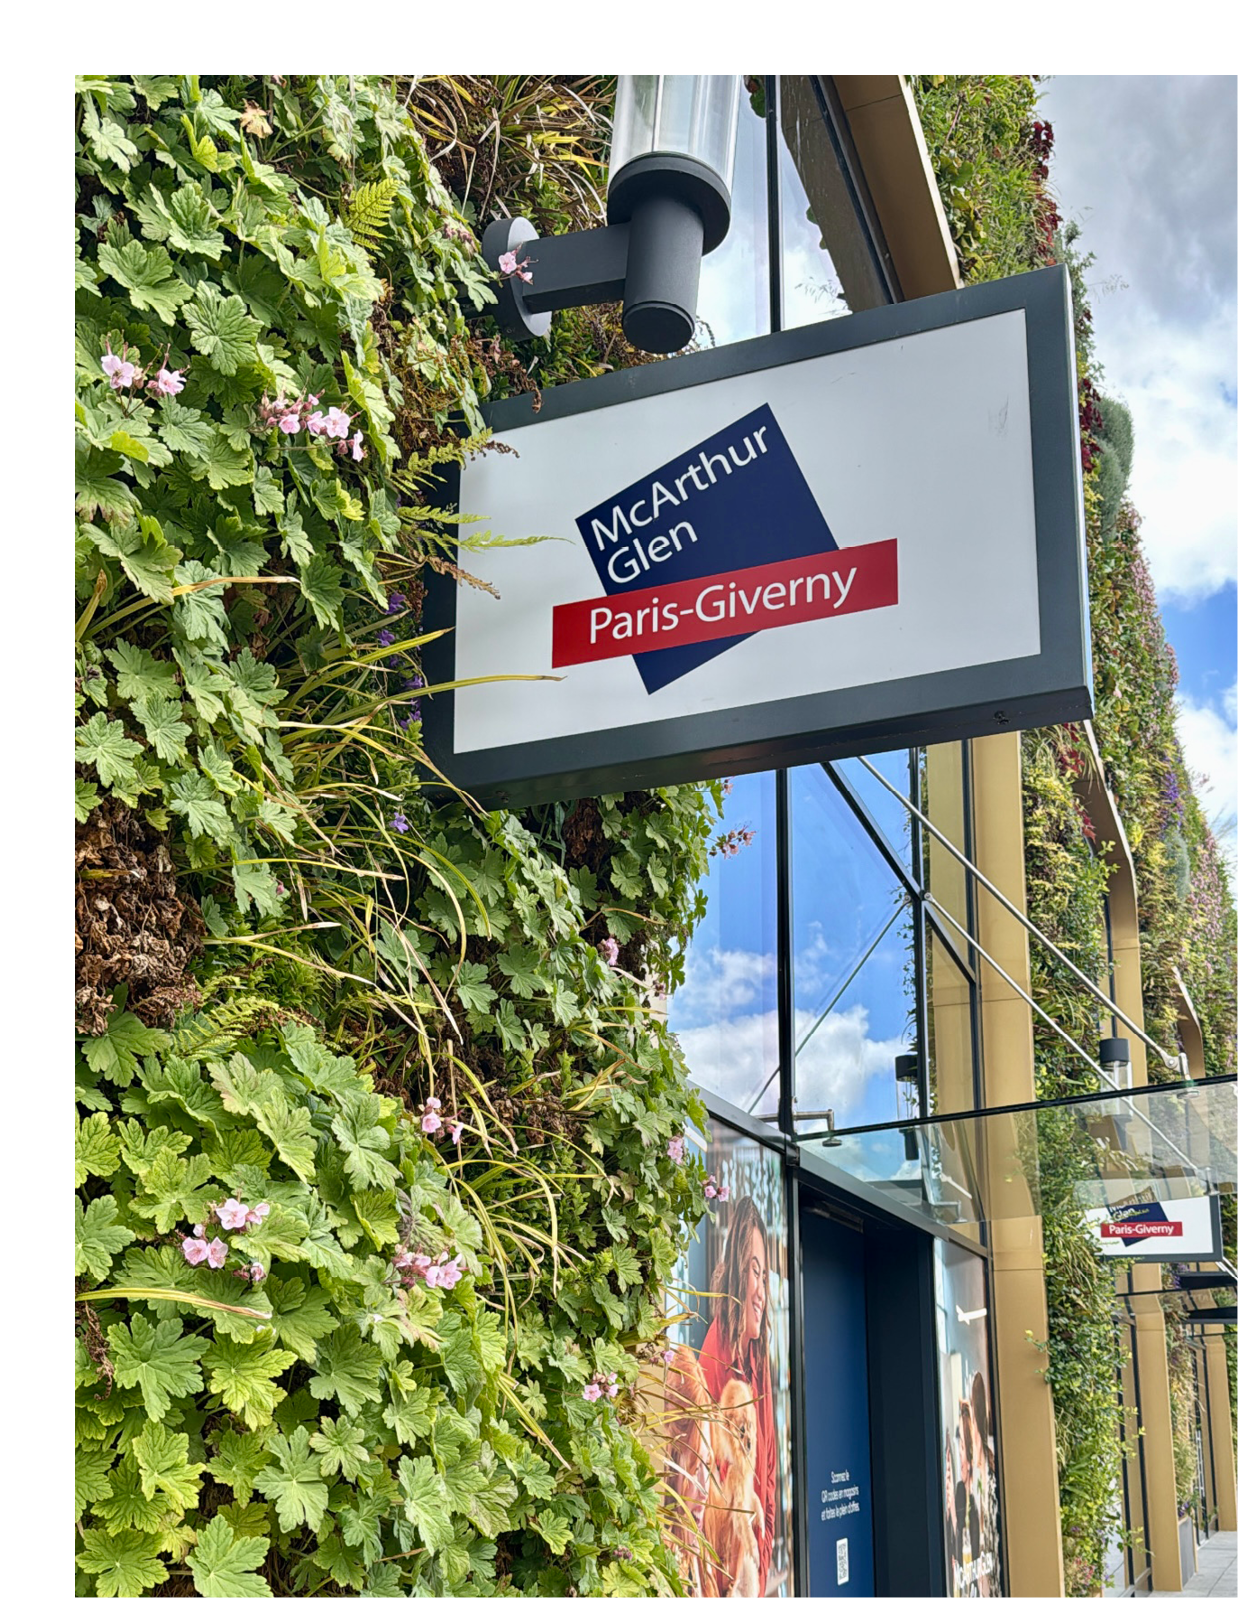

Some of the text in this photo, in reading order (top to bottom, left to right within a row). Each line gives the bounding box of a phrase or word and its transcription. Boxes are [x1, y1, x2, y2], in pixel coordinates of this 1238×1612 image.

[591, 426, 767, 551] McArthur
[607, 520, 698, 584] Glen
[590, 567, 857, 644] Paris-Giverny
[1108, 1224, 1174, 1236] Paris-Giverny
